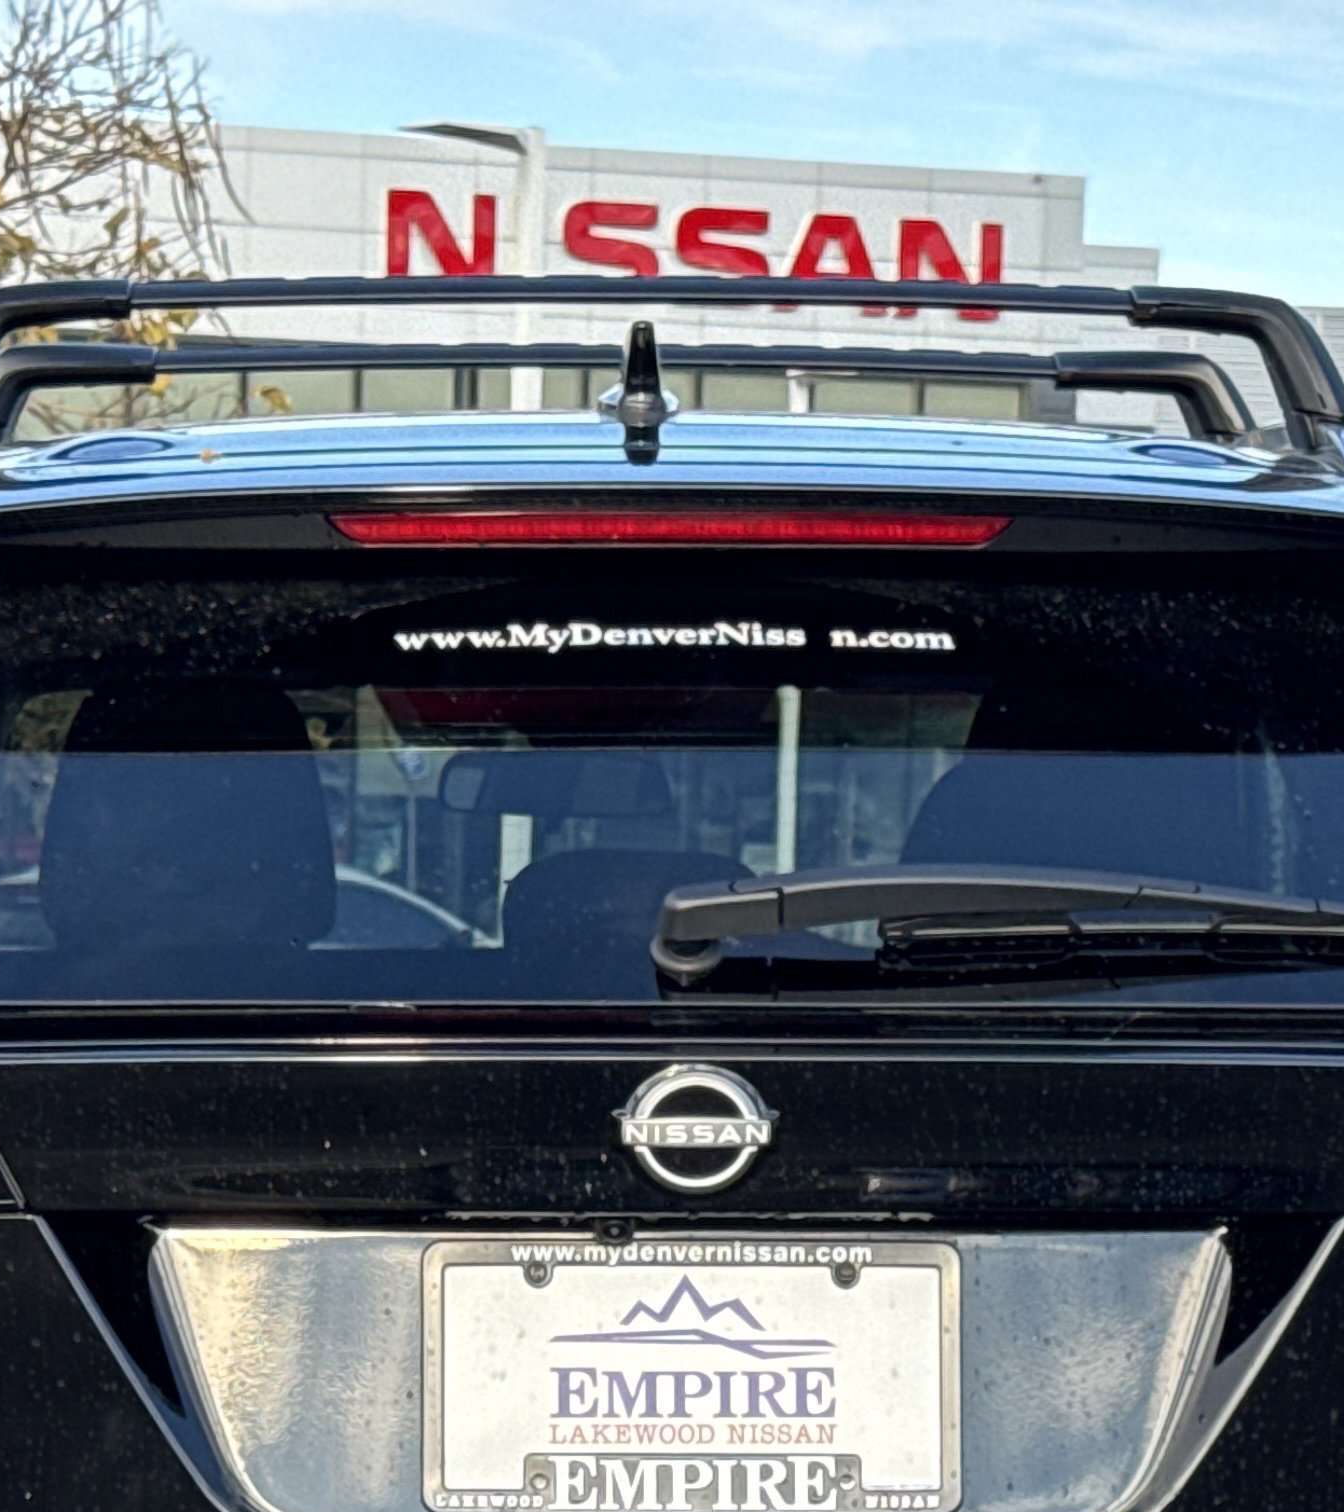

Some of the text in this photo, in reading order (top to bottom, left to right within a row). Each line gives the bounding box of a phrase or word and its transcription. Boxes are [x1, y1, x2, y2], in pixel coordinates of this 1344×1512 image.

[386, 189, 1004, 320] NSSAN
[624, 1123, 769, 1144] NISSAN
[510, 1241, 873, 1267] www.mydenvernissan.com
[549, 1367, 837, 1419] EMPIRE
[549, 1423, 838, 1445] LAKEWOOD NISSAN
[547, 1455, 838, 1512] EMPIRE
